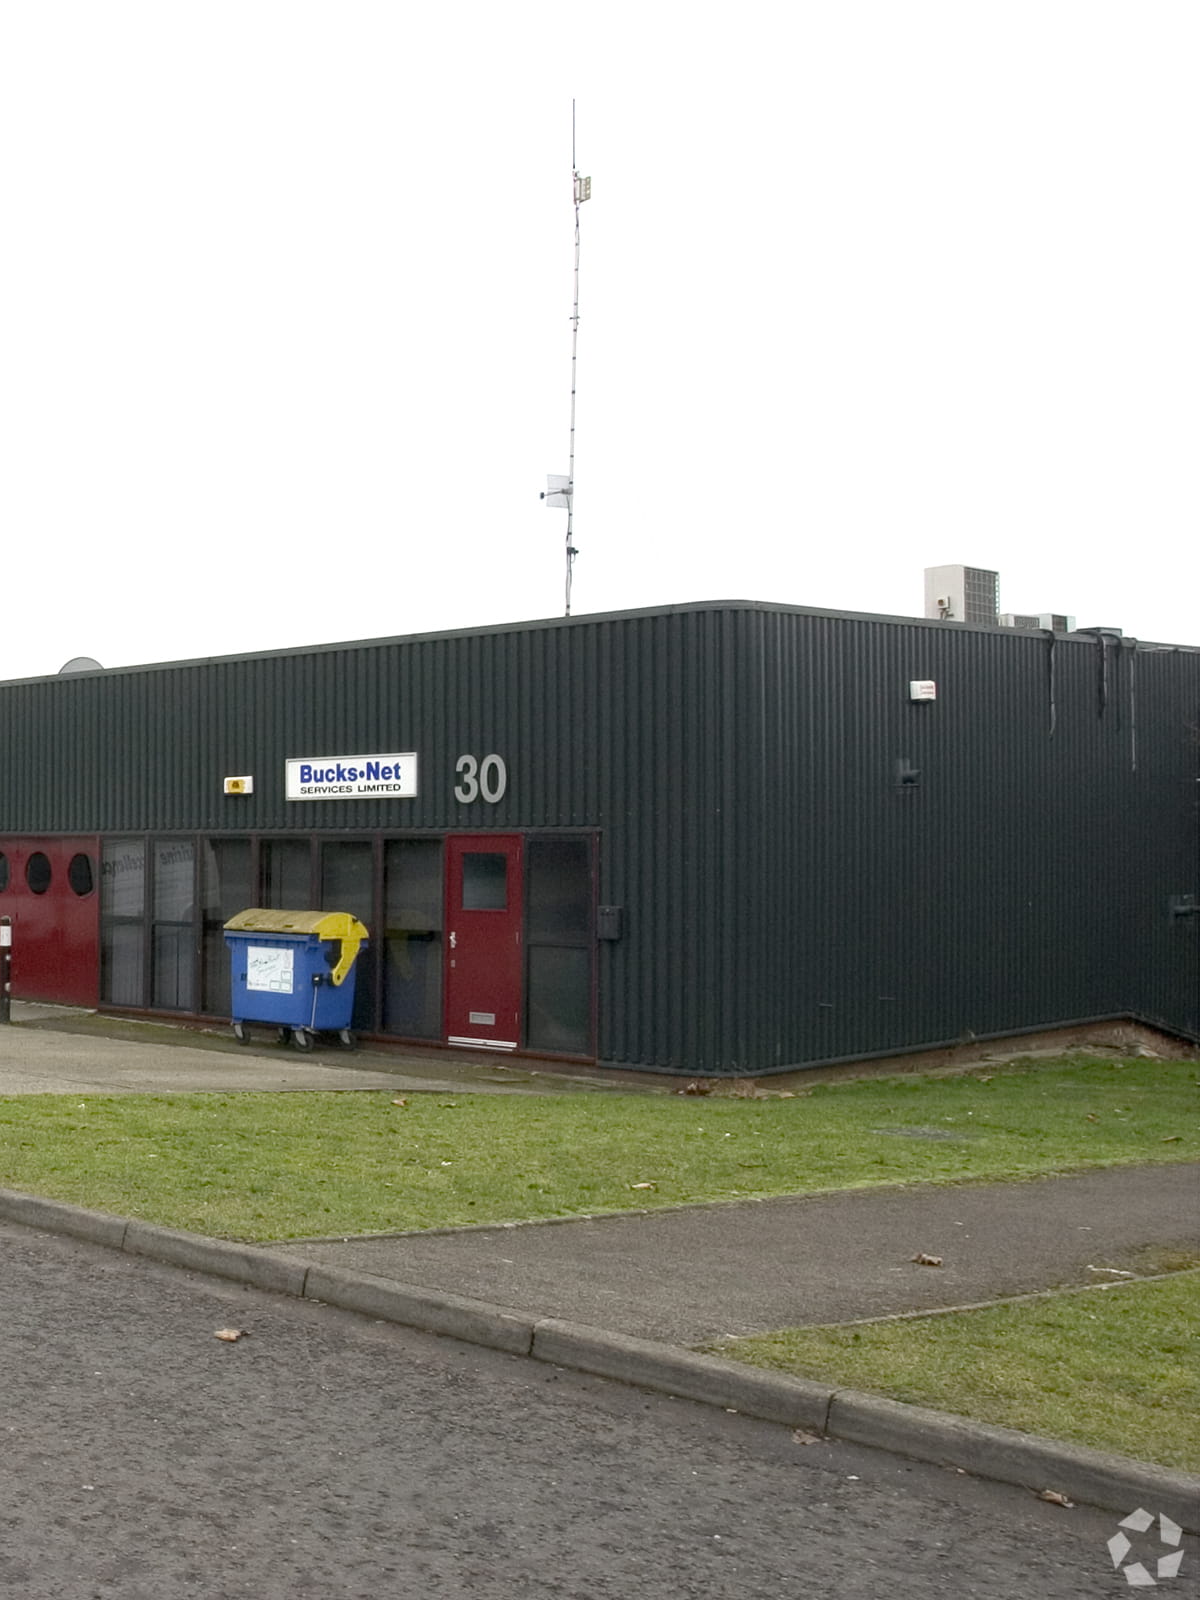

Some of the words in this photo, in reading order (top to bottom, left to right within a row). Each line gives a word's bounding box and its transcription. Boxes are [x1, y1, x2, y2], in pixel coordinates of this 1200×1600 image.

[300, 785, 353, 795] SERVICES
[357, 783, 401, 793] LIMITED
[454, 753, 507, 804] 30
